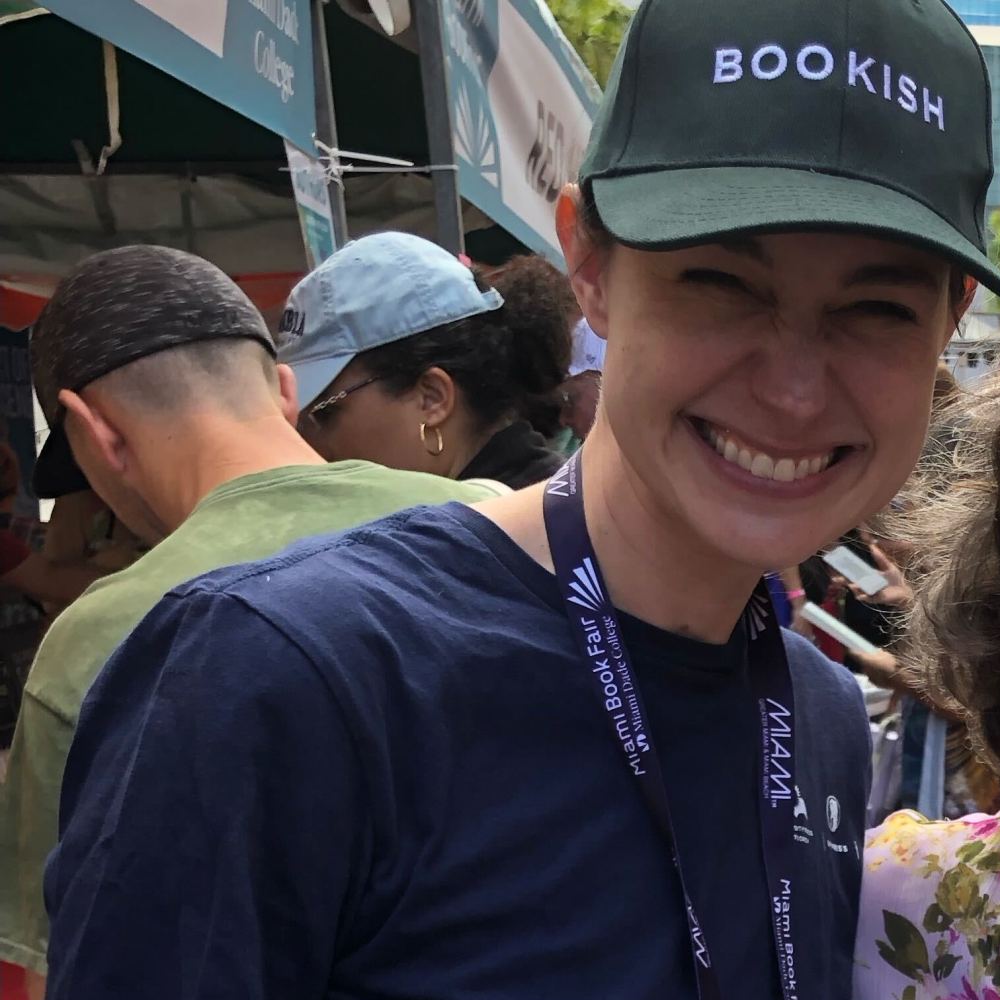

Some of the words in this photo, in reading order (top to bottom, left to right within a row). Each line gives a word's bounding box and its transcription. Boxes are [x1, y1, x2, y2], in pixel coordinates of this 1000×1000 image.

[713, 45, 945, 131] BOOKISH
[581, 617, 606, 656] Fair
[602, 616, 622, 659] College
[592, 658, 622, 711] Book
[617, 661, 633, 692] Dade
[625, 694, 645, 731] Miami
[613, 713, 646, 775] Miami
[766, 698, 791, 799] MIAMI
[780, 879, 791, 938] Miami
[785, 943, 796, 990] Book
